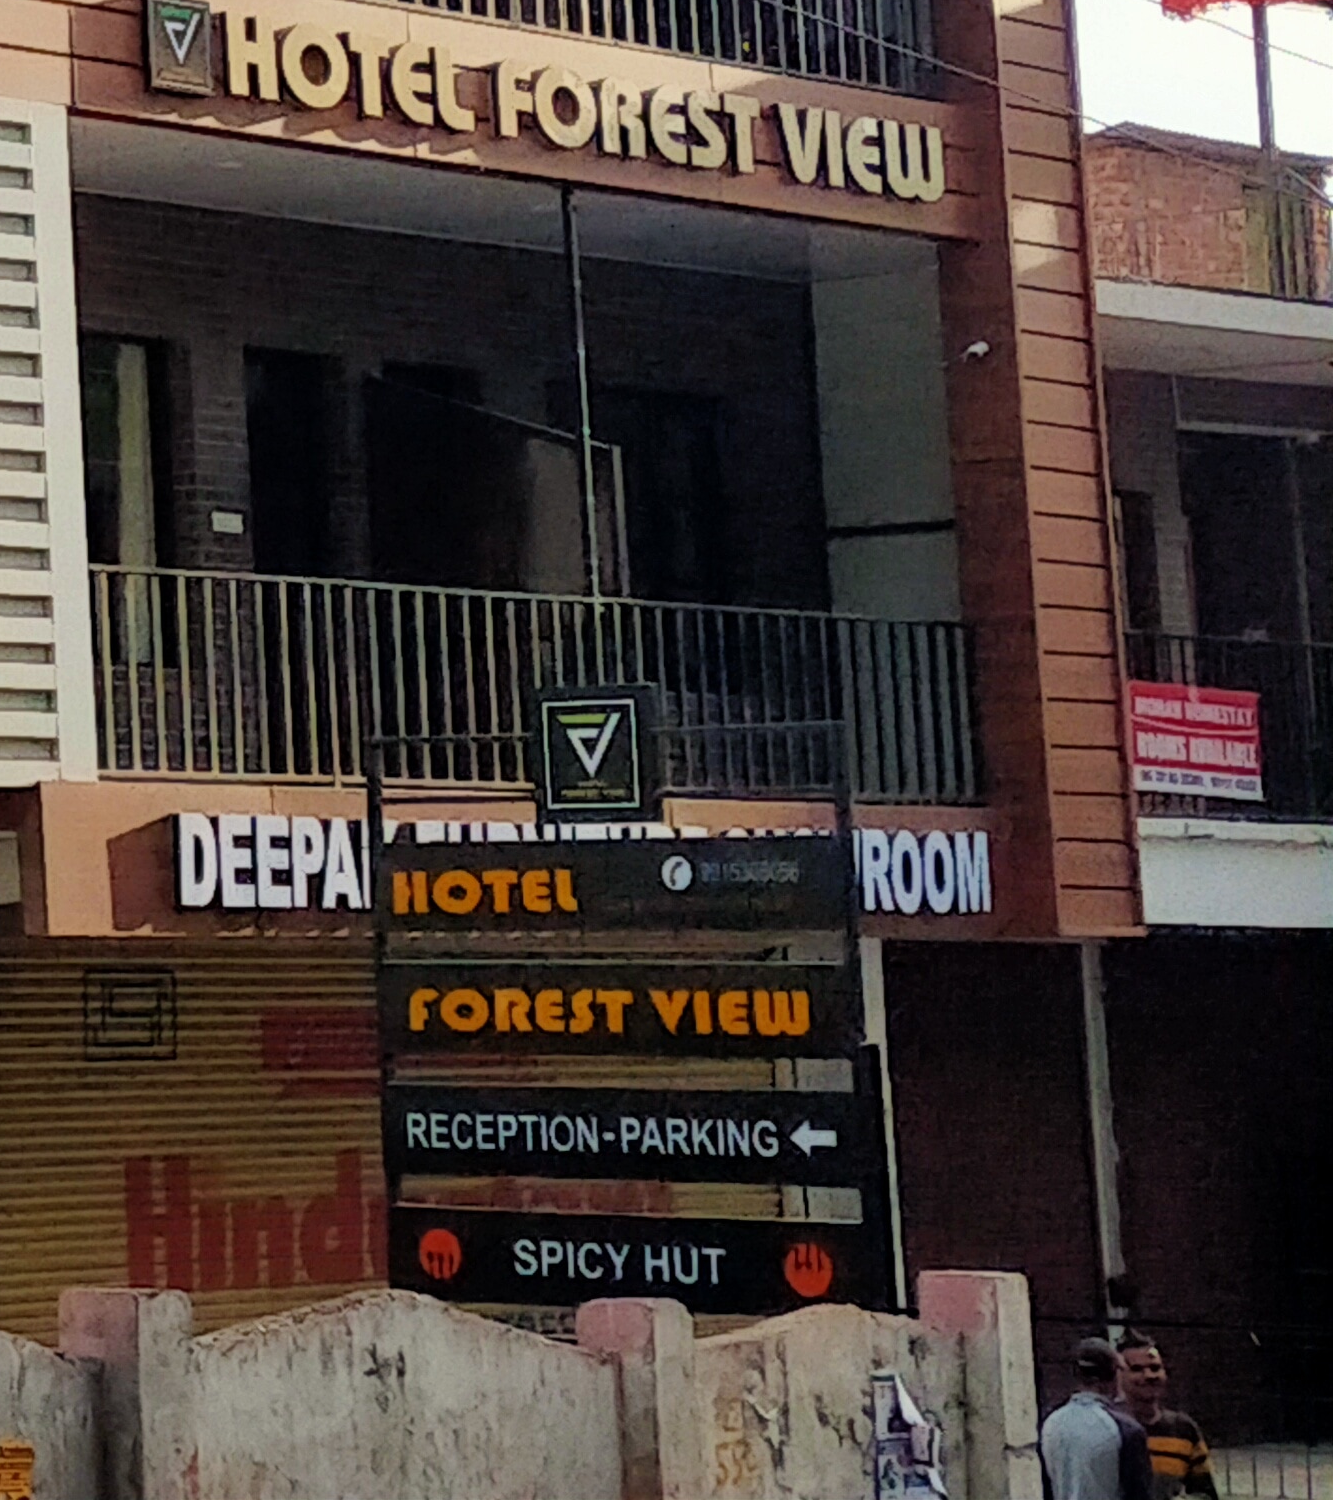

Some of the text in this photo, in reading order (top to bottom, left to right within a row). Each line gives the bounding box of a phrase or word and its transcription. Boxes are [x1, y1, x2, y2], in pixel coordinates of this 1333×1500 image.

[221, 11, 946, 203] HOTEL FOREST VIEW
[391, 869, 579, 915] HOTEL
[408, 987, 811, 1037] FOREST VIEW
[405, 1112, 780, 1158] RECEPTION-PARKING
[512, 1237, 727, 1286] SPICY HUT
